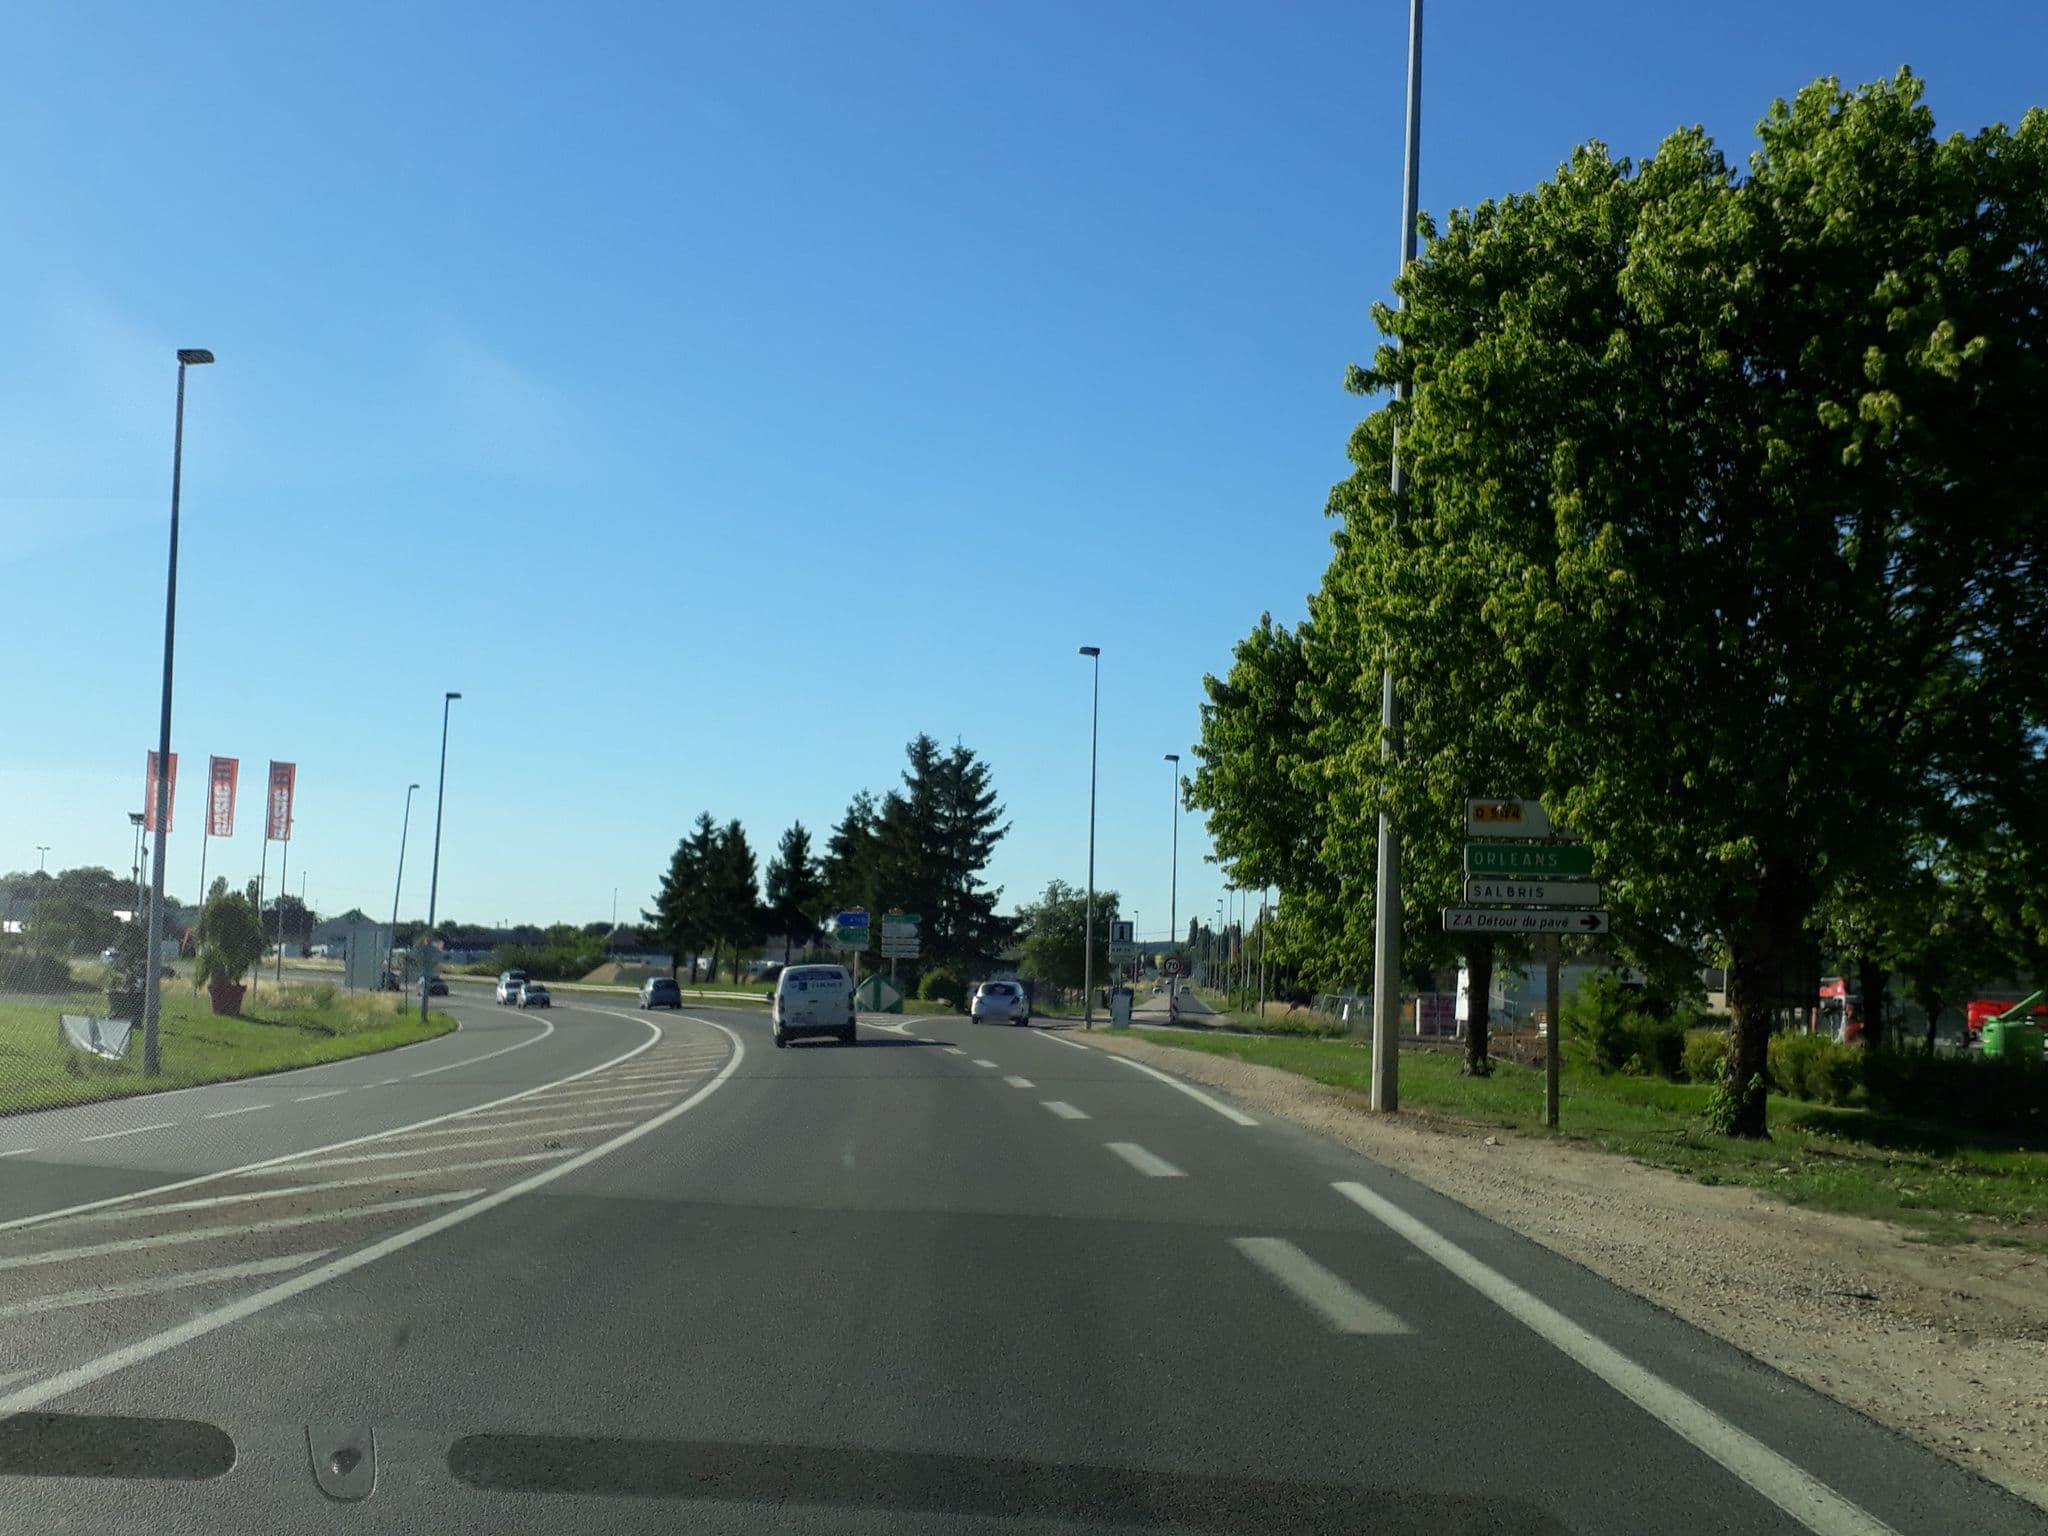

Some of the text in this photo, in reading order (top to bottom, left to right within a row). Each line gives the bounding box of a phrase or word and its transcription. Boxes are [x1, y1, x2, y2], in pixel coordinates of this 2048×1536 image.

[1474, 852, 1558, 867] ORLEANS
[1473, 886, 1545, 898] SALBRIS
[1477, 914, 1518, 928] Détour
[1522, 915, 1536, 927] du
[1539, 917, 1569, 930] pavé
[1167, 961, 1178, 970] 70
